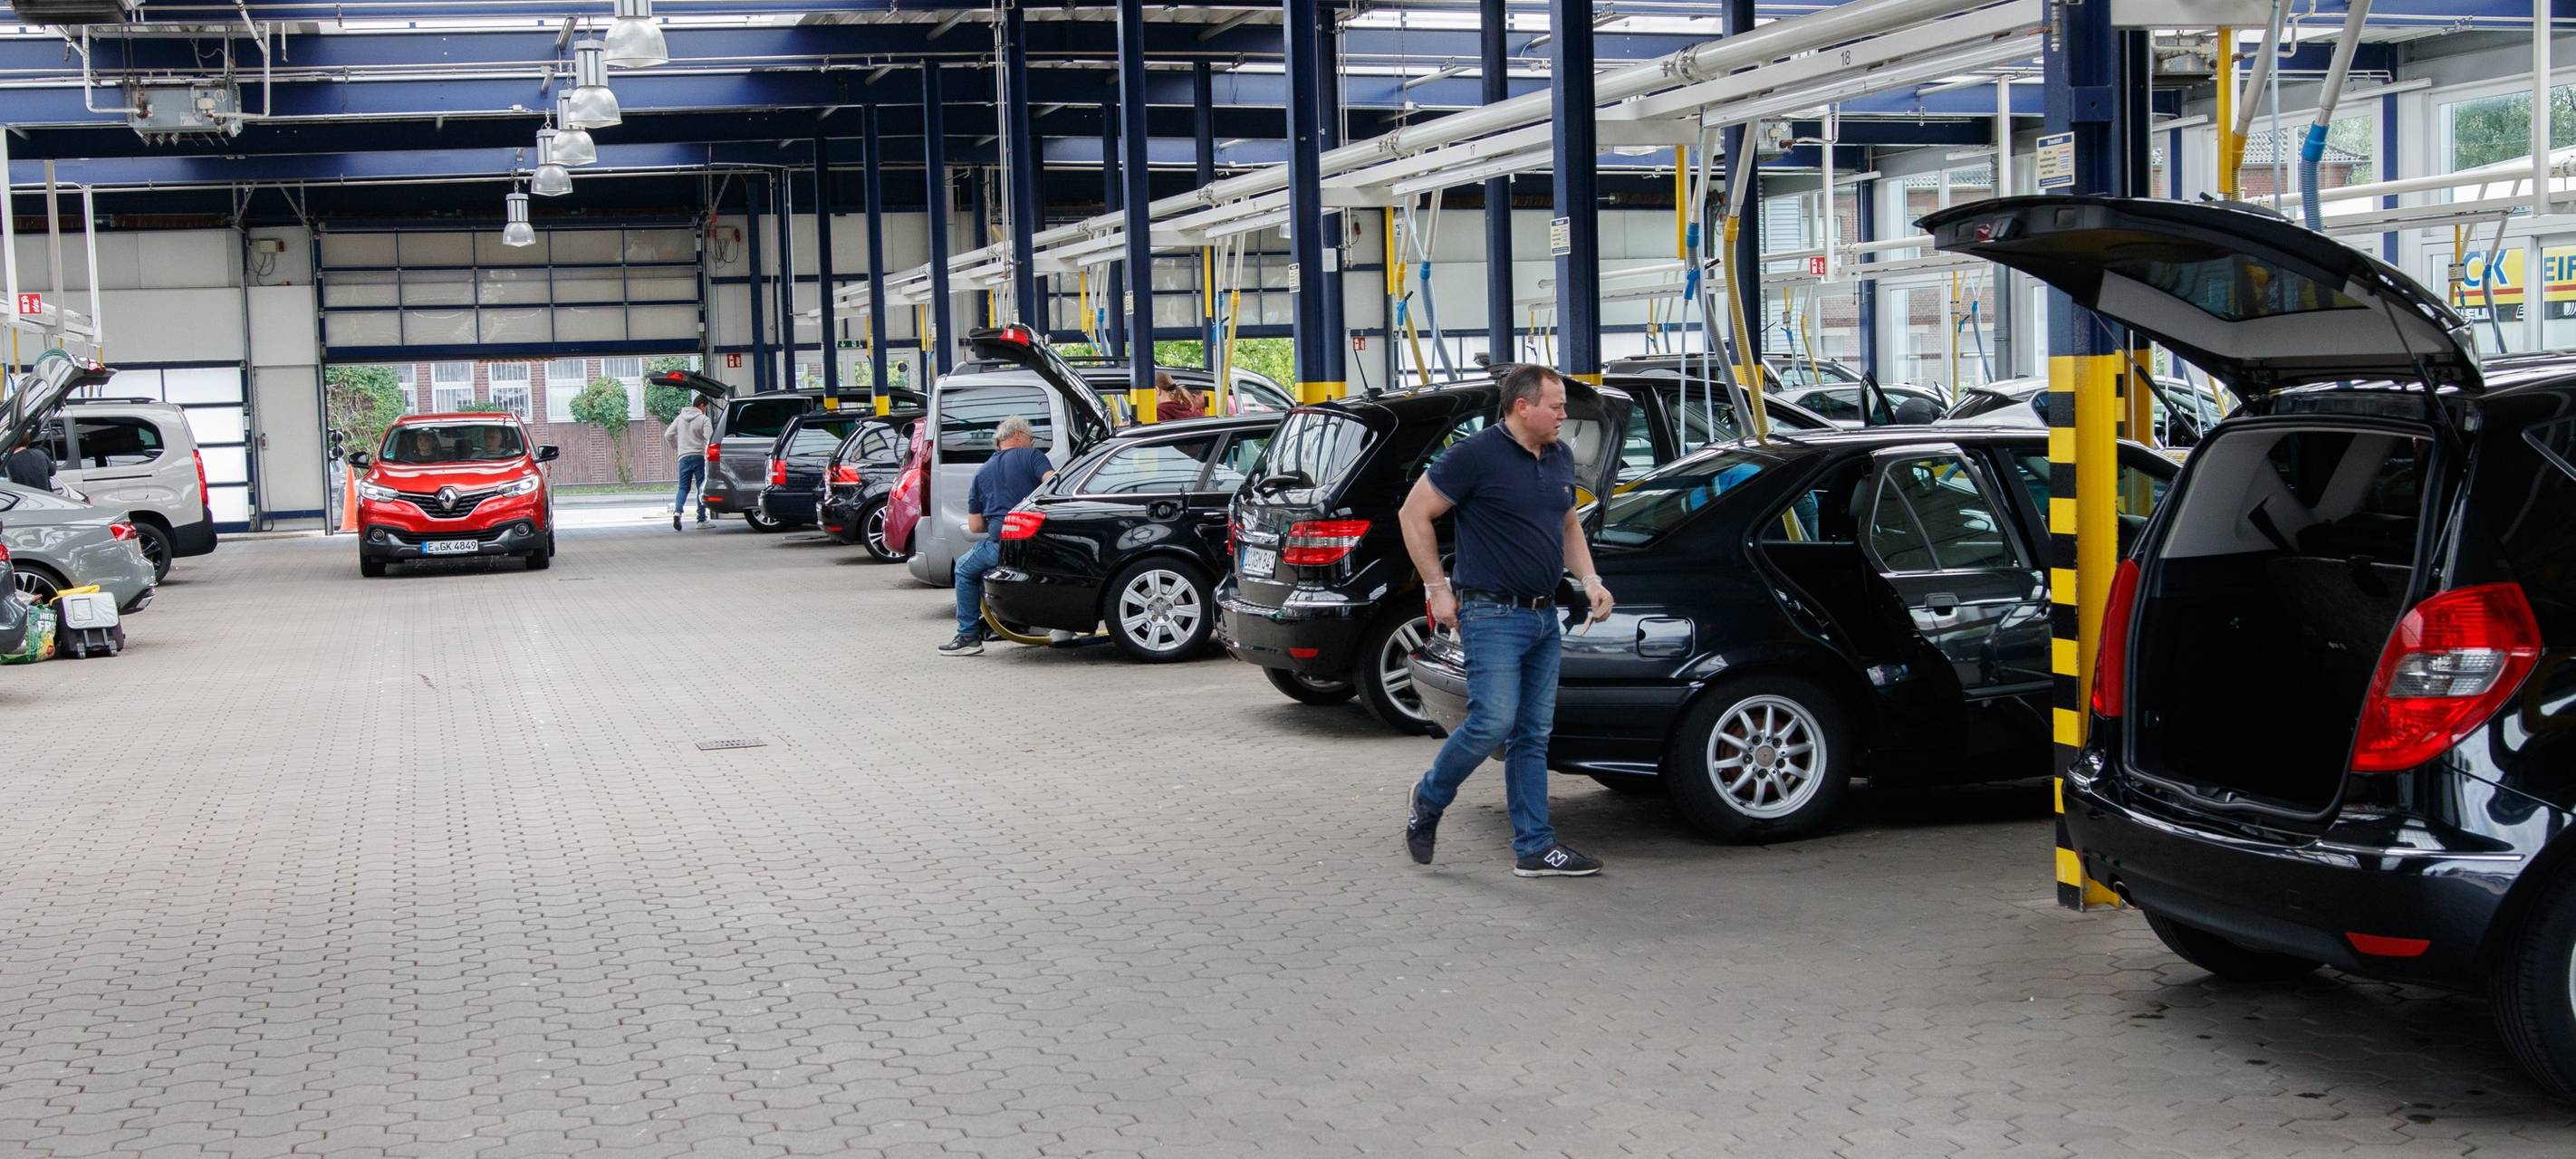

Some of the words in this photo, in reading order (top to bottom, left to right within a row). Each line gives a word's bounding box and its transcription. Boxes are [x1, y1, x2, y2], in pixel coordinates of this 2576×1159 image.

[1841, 50, 1851, 66] 18
[428, 542, 435, 551] E
[440, 541, 452, 551] GK
[454, 541, 477, 551] 4849
[1544, 849, 1568, 867] N
